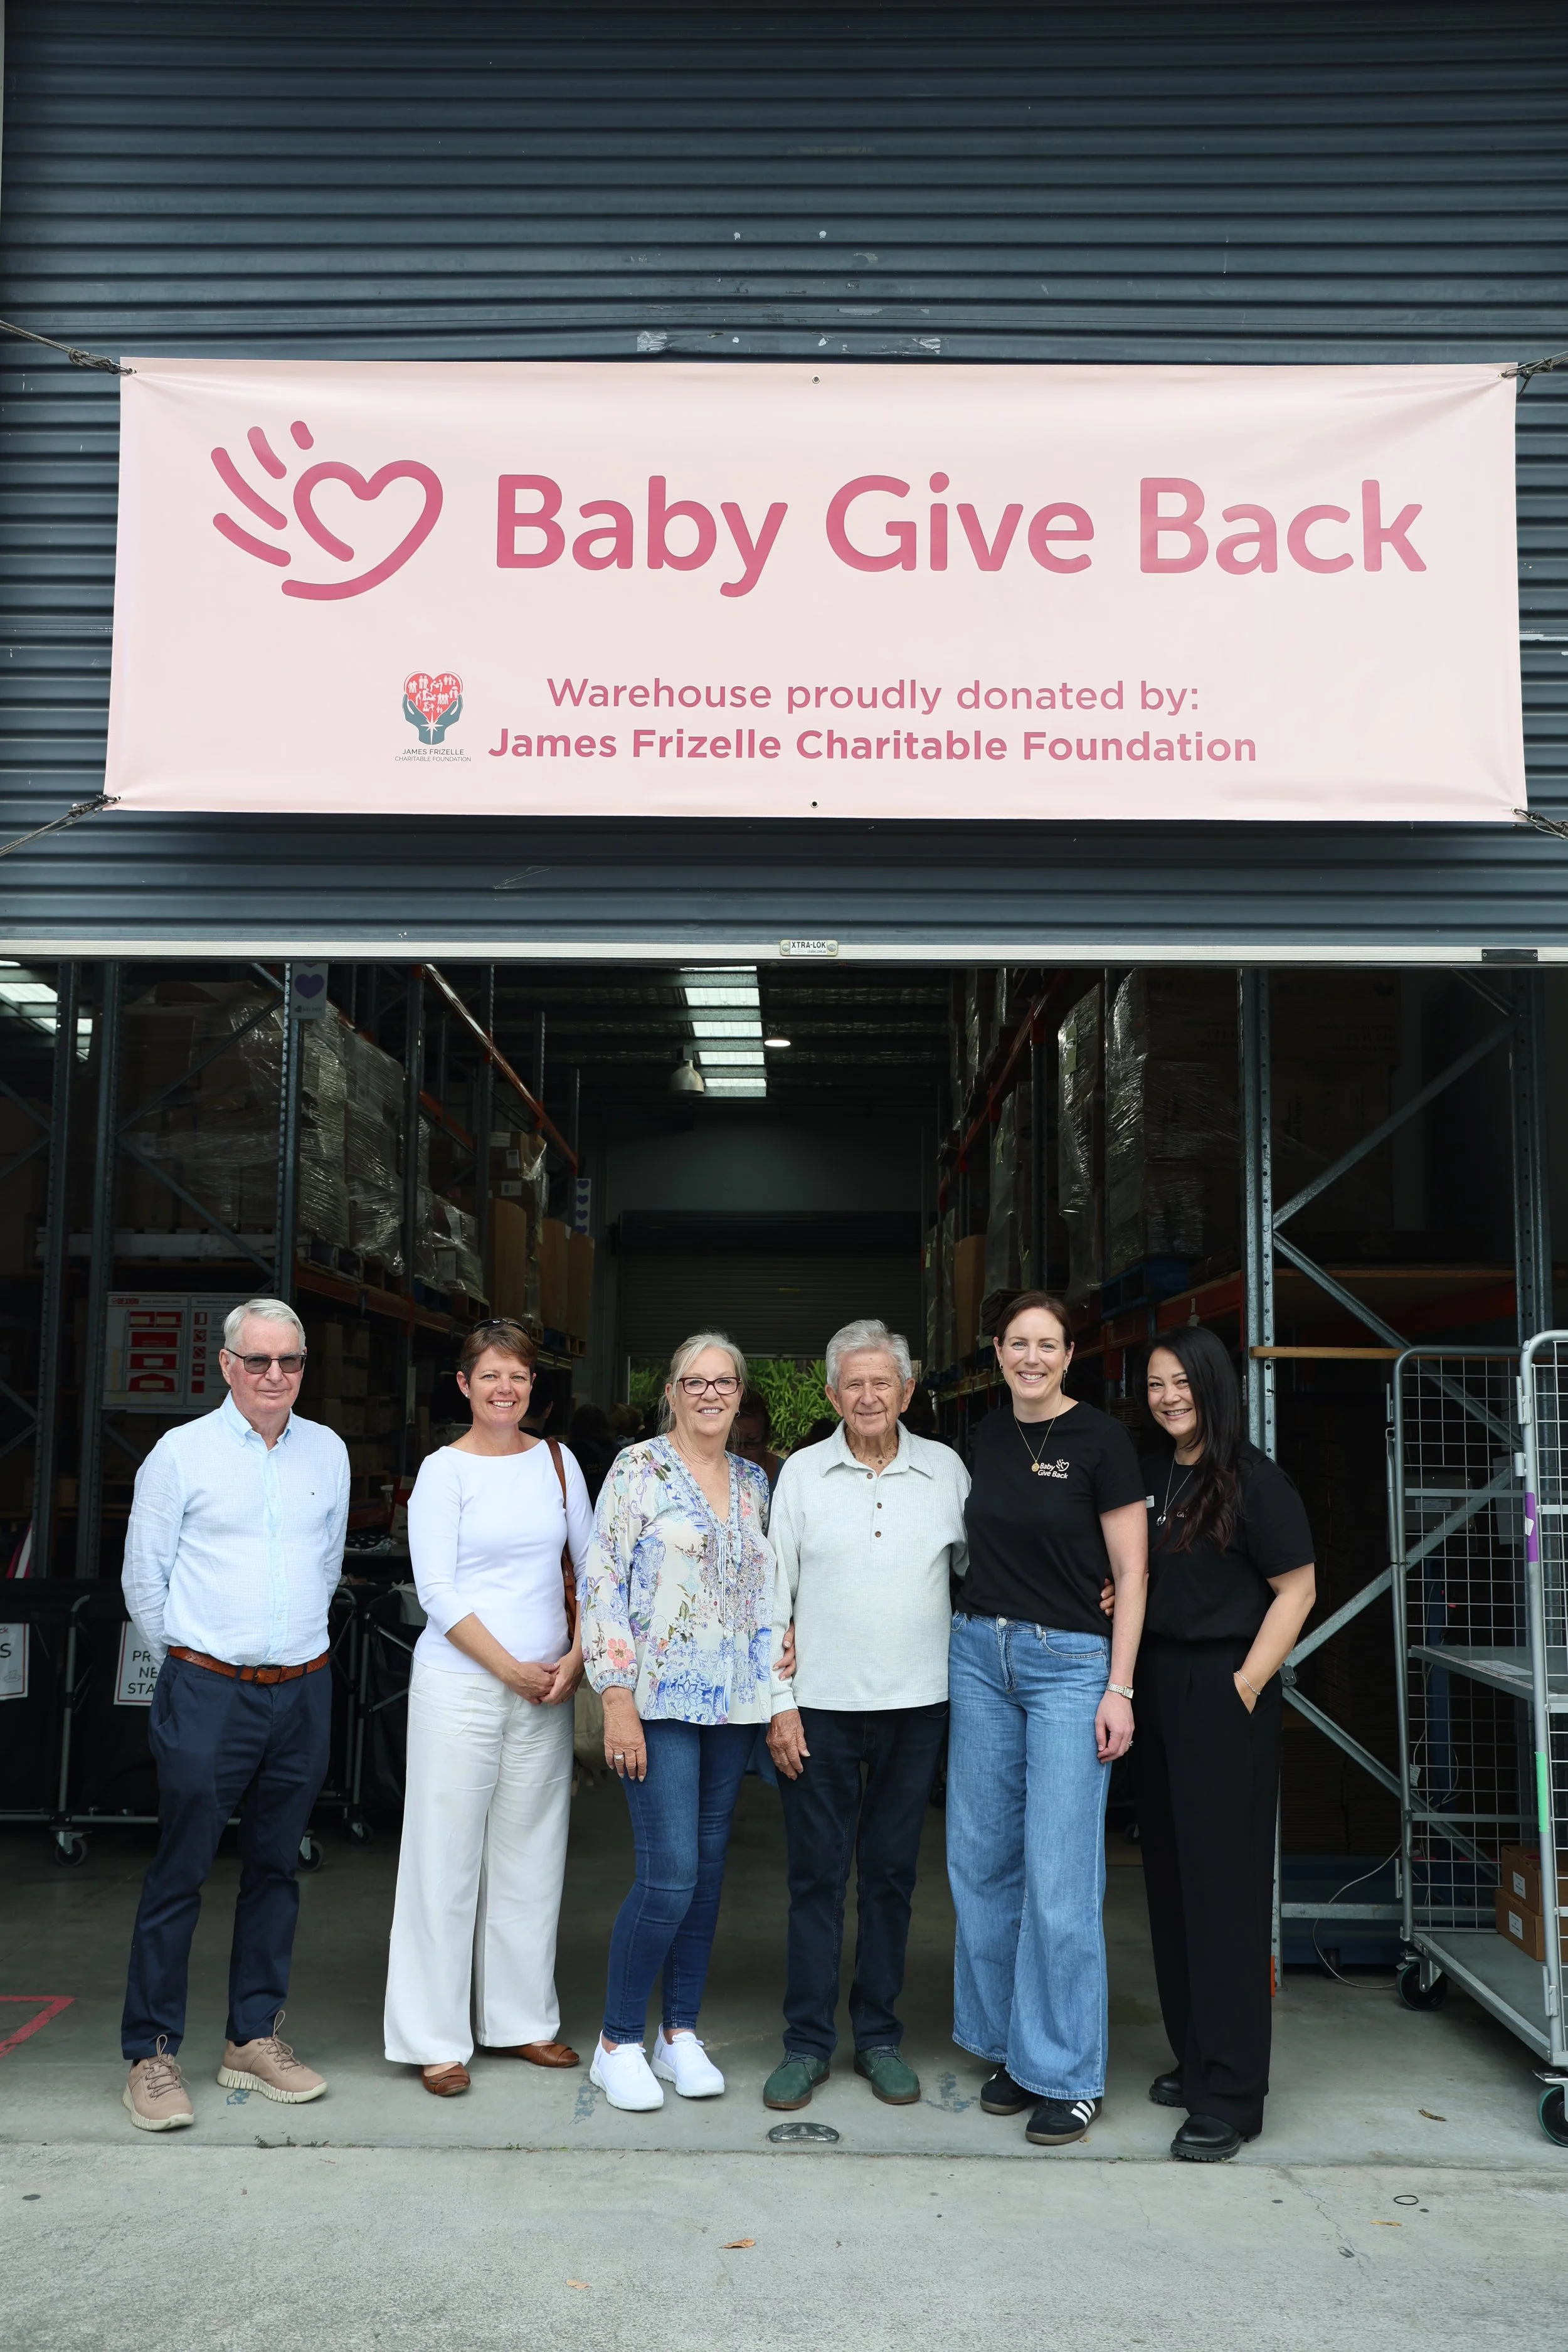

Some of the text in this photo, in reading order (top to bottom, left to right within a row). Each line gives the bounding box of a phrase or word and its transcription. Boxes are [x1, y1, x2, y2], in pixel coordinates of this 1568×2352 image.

[497, 472, 1427, 599] Baby Give Back
[548, 679, 1199, 716] Warehouse proudly donated by:
[489, 729, 1256, 763] James Frizelle Charitable Foundation
[1039, 1463, 1056, 1471] Baby
[1051, 1471, 1069, 1479] Back
